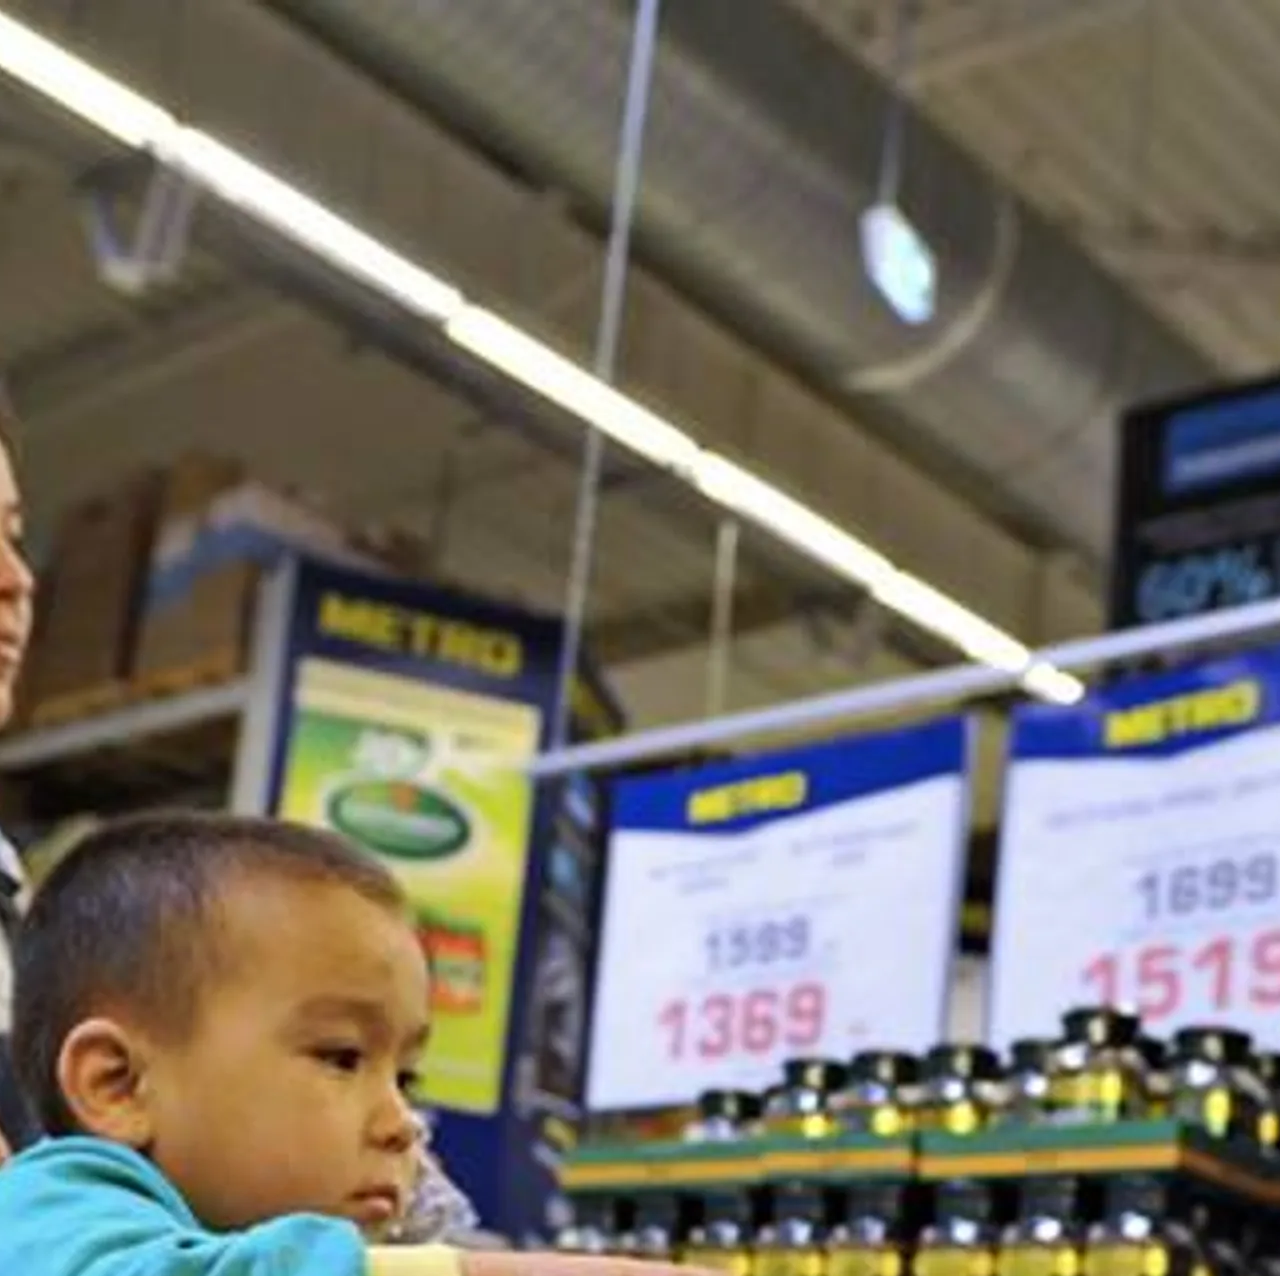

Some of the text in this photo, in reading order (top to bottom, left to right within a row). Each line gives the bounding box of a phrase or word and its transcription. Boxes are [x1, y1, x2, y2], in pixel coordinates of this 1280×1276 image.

[319, 592, 523, 678] METRO
[1104, 678, 1260, 748] METRO
[1136, 854, 1276, 921] 1699
[658, 982, 826, 1063] 1369
